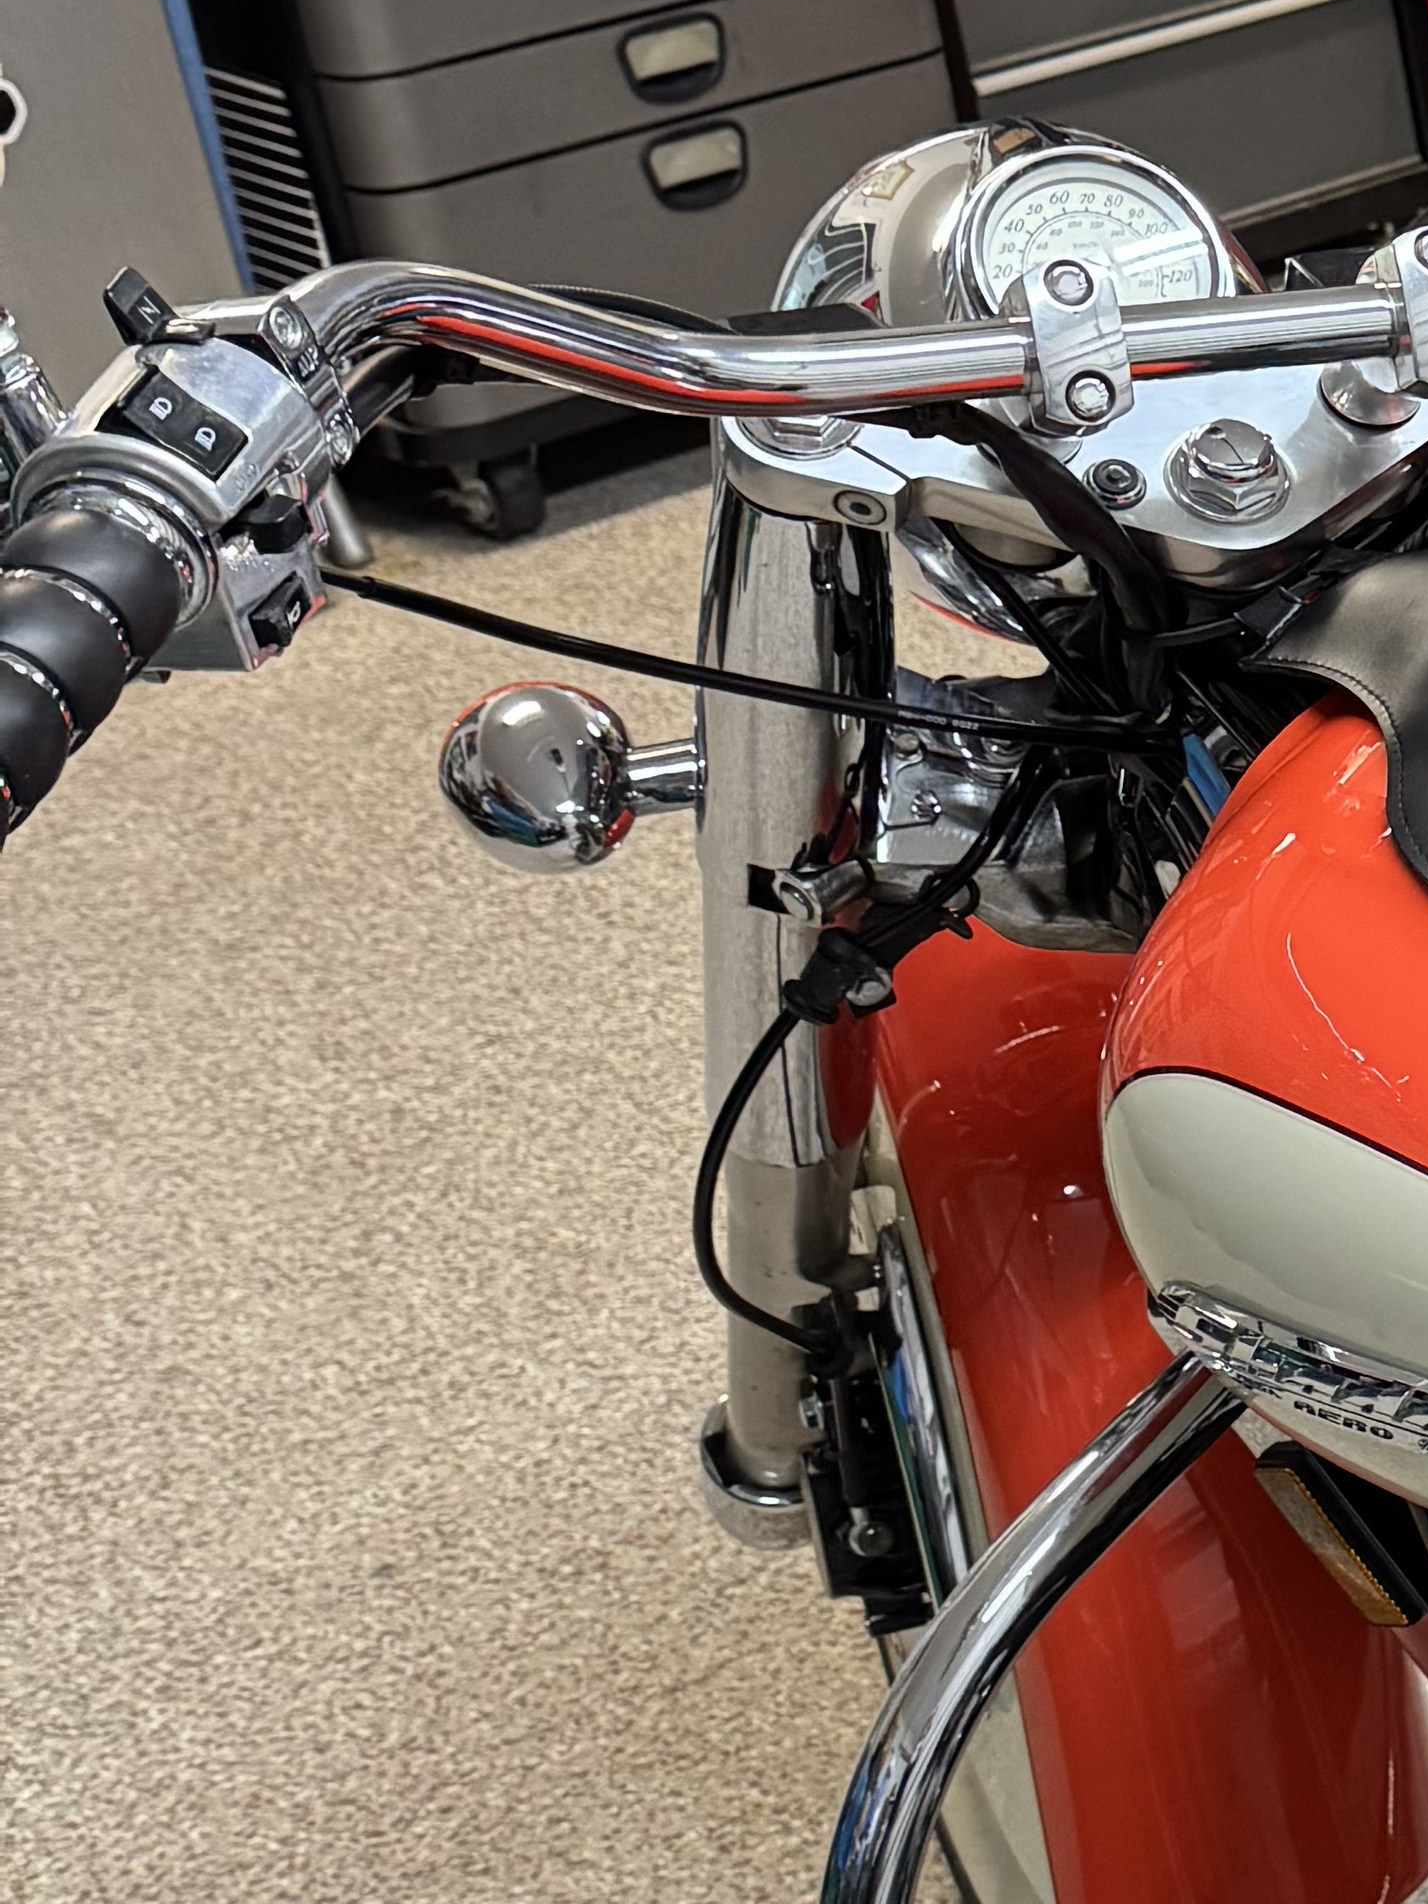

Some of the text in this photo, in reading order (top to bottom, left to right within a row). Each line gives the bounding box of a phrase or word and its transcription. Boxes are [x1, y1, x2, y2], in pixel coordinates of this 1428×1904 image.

[1049, 190, 1069, 205] 60
[1079, 192, 1095, 205] 70
[1103, 194, 1123, 208] 80
[1025, 203, 1043, 216] 50
[1128, 207, 1145, 219] 90
[1003, 217, 1025, 234] 40
[1000, 241, 1016, 254] 30
[993, 263, 1014, 279] 20
[1293, 1399, 1395, 1441] AERO
